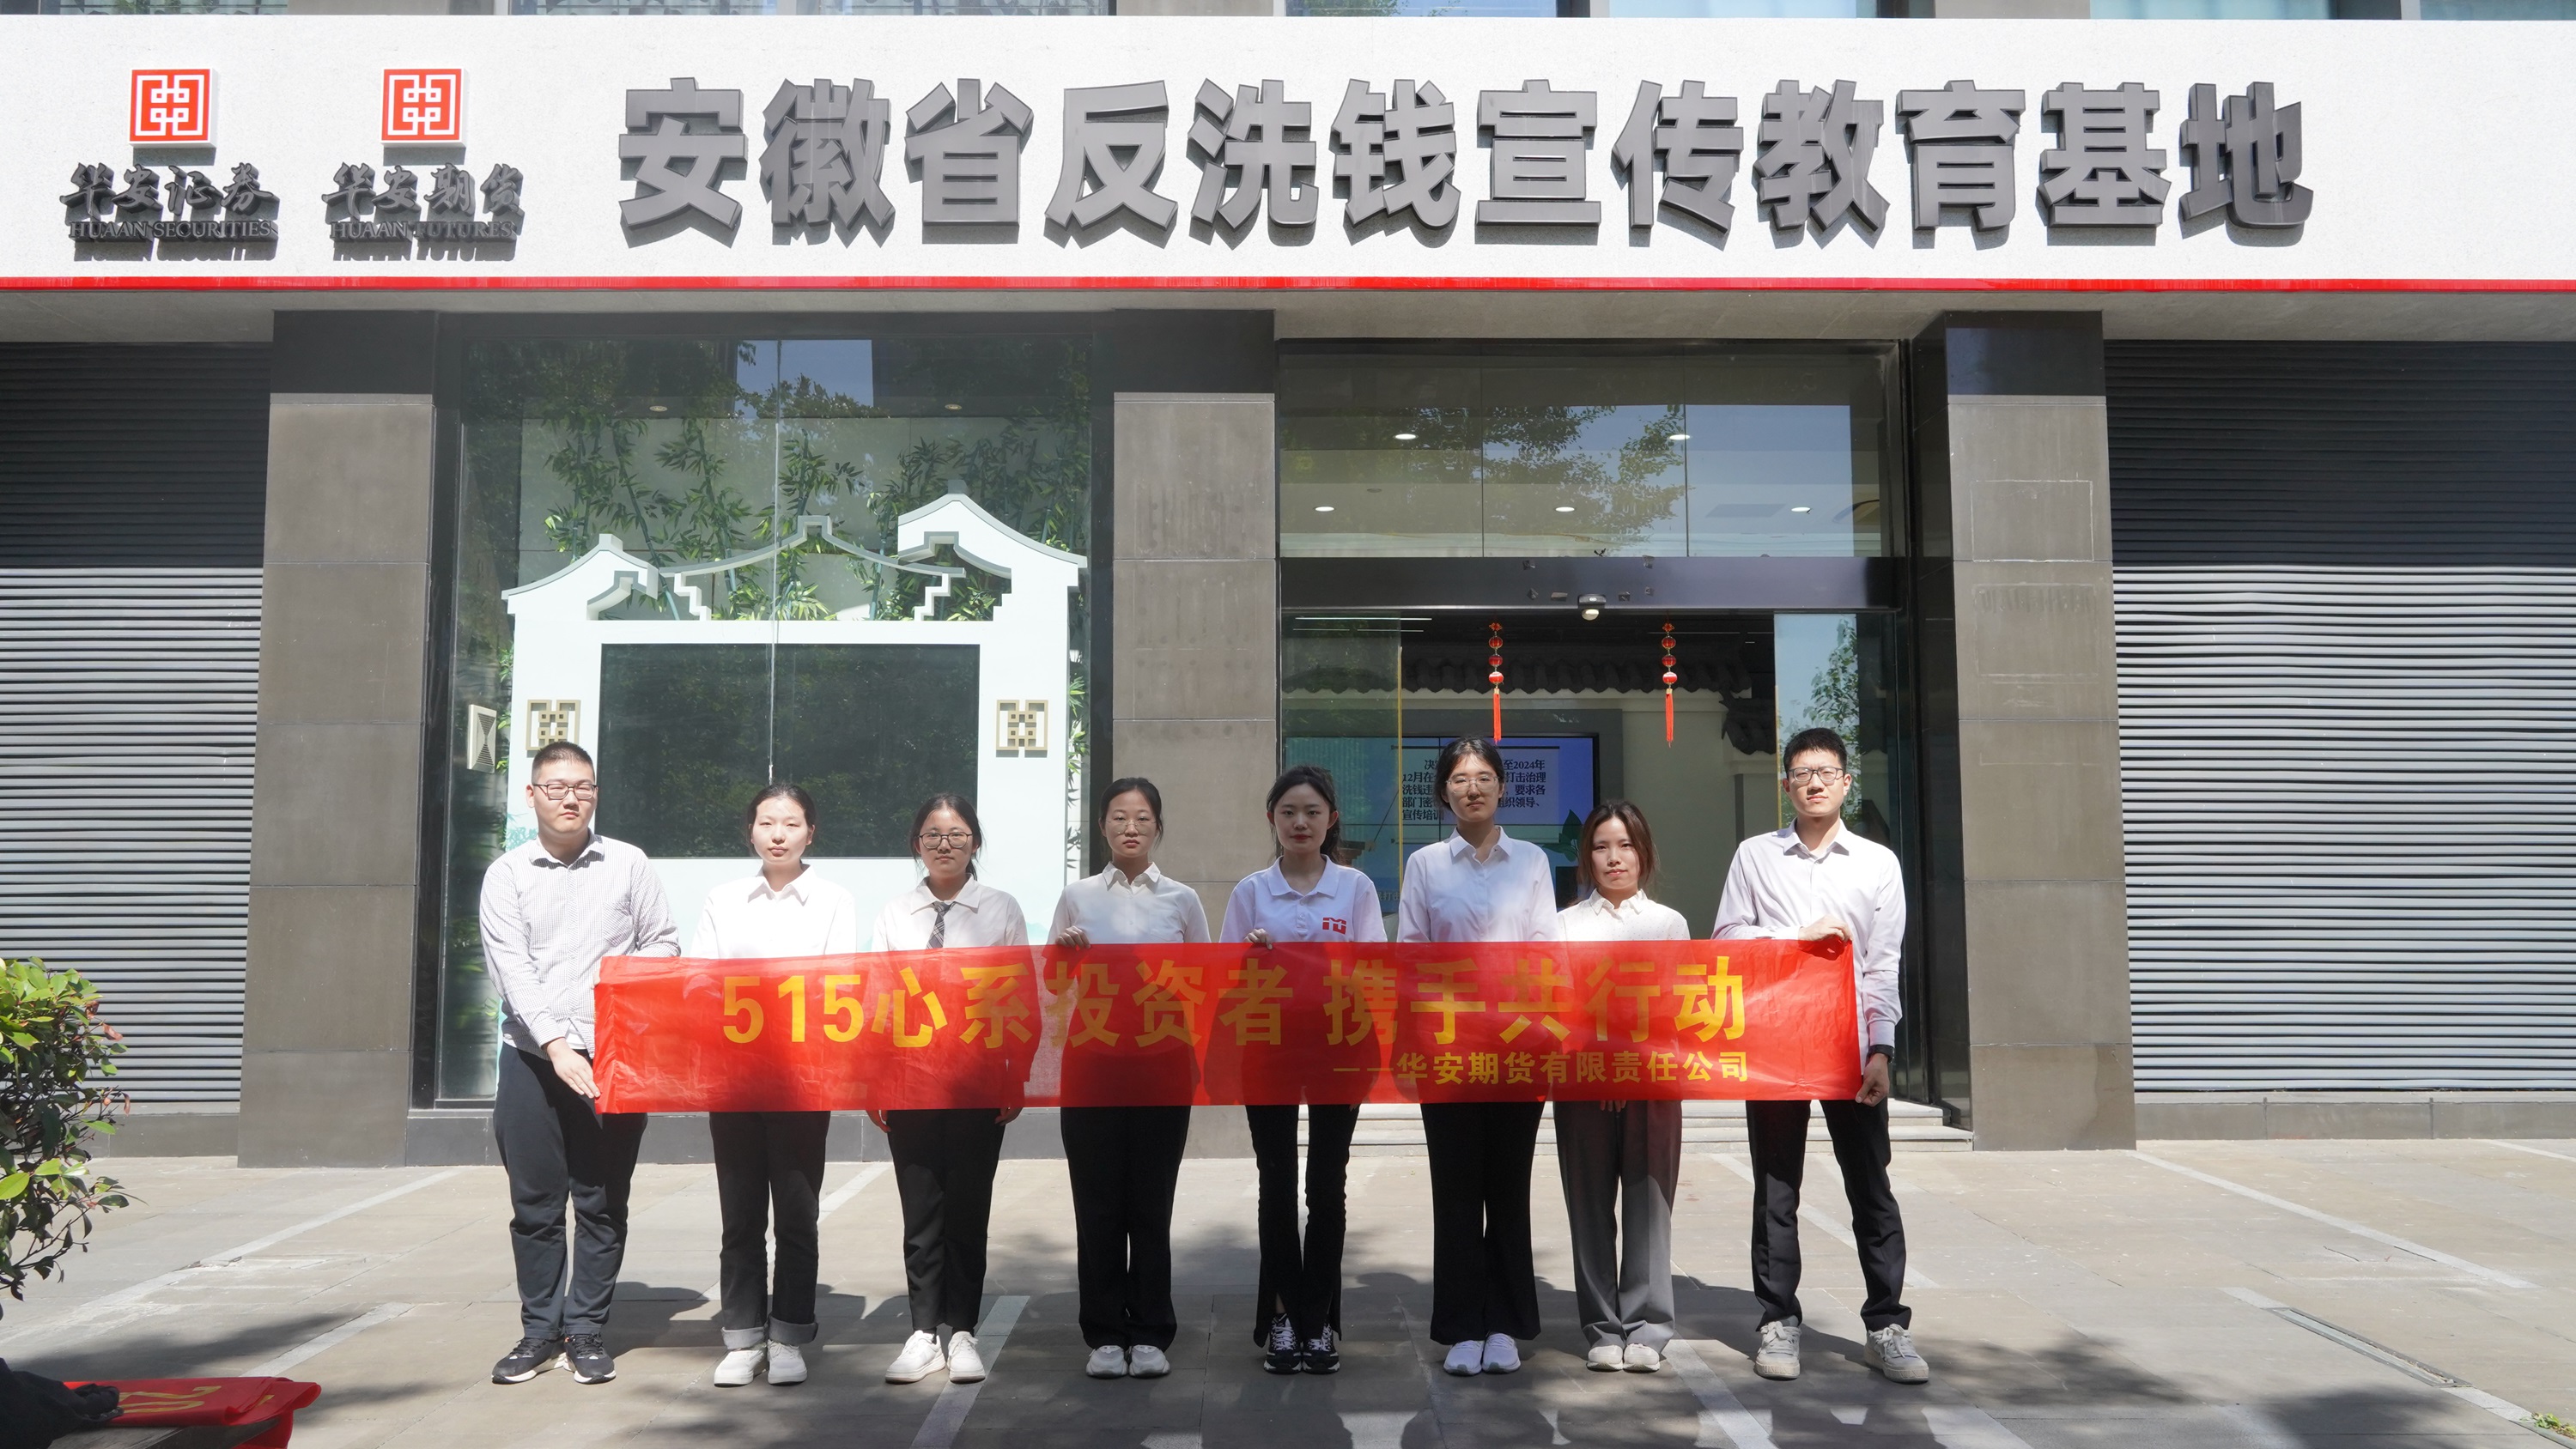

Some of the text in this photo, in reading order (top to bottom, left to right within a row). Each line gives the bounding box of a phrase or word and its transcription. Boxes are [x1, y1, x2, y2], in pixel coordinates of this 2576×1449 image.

[618, 76, 2314, 232] 安徽省反洗钱宣传教育基地
[59, 162, 279, 216] 华安证券
[322, 162, 523, 218] 华安期货
[70, 221, 273, 239] HUAAN SECURITIES
[331, 221, 514, 239] HUAAN FUTURES
[1402, 771, 1437, 783] 12月在
[722, 955, 1747, 1049] 515心系投资者 携手共行动
